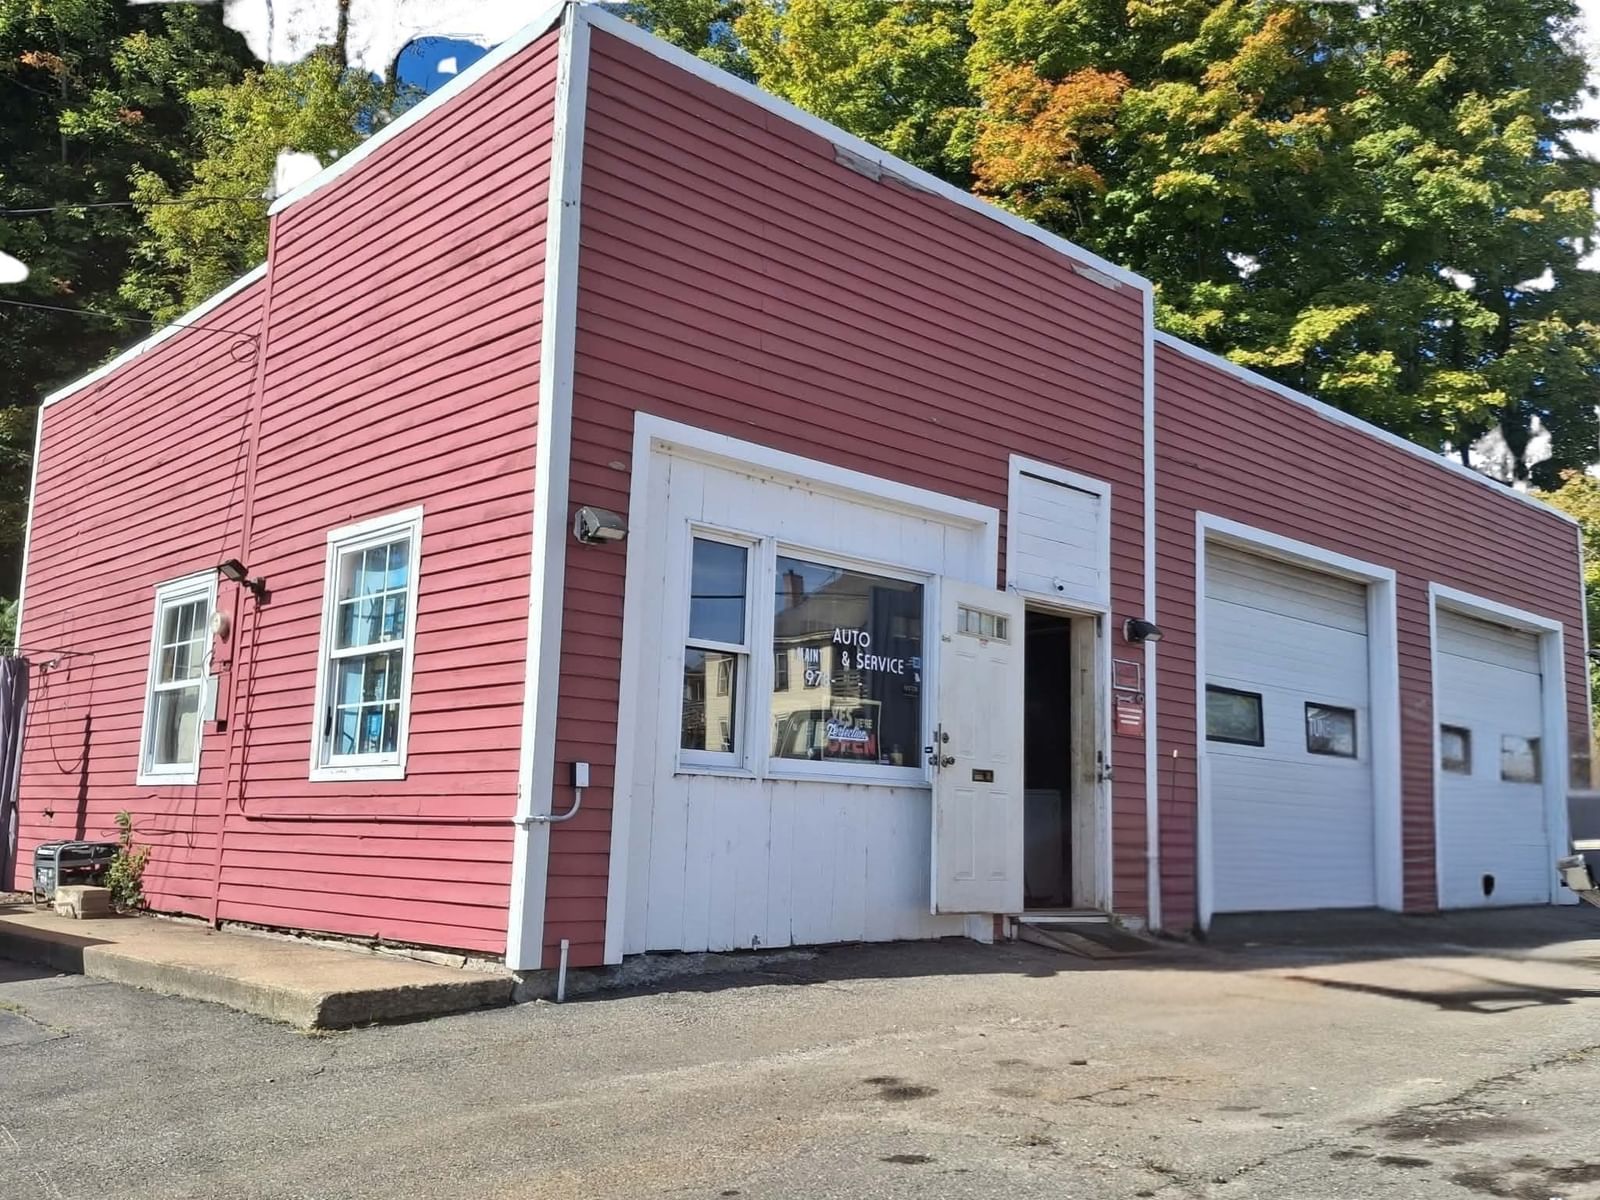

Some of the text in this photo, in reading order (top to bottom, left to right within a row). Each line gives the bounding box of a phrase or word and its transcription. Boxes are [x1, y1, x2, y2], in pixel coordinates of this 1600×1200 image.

[833, 628, 871, 648] AUTO
[842, 651, 850, 666] &
[856, 653, 904, 675] SERVICE
